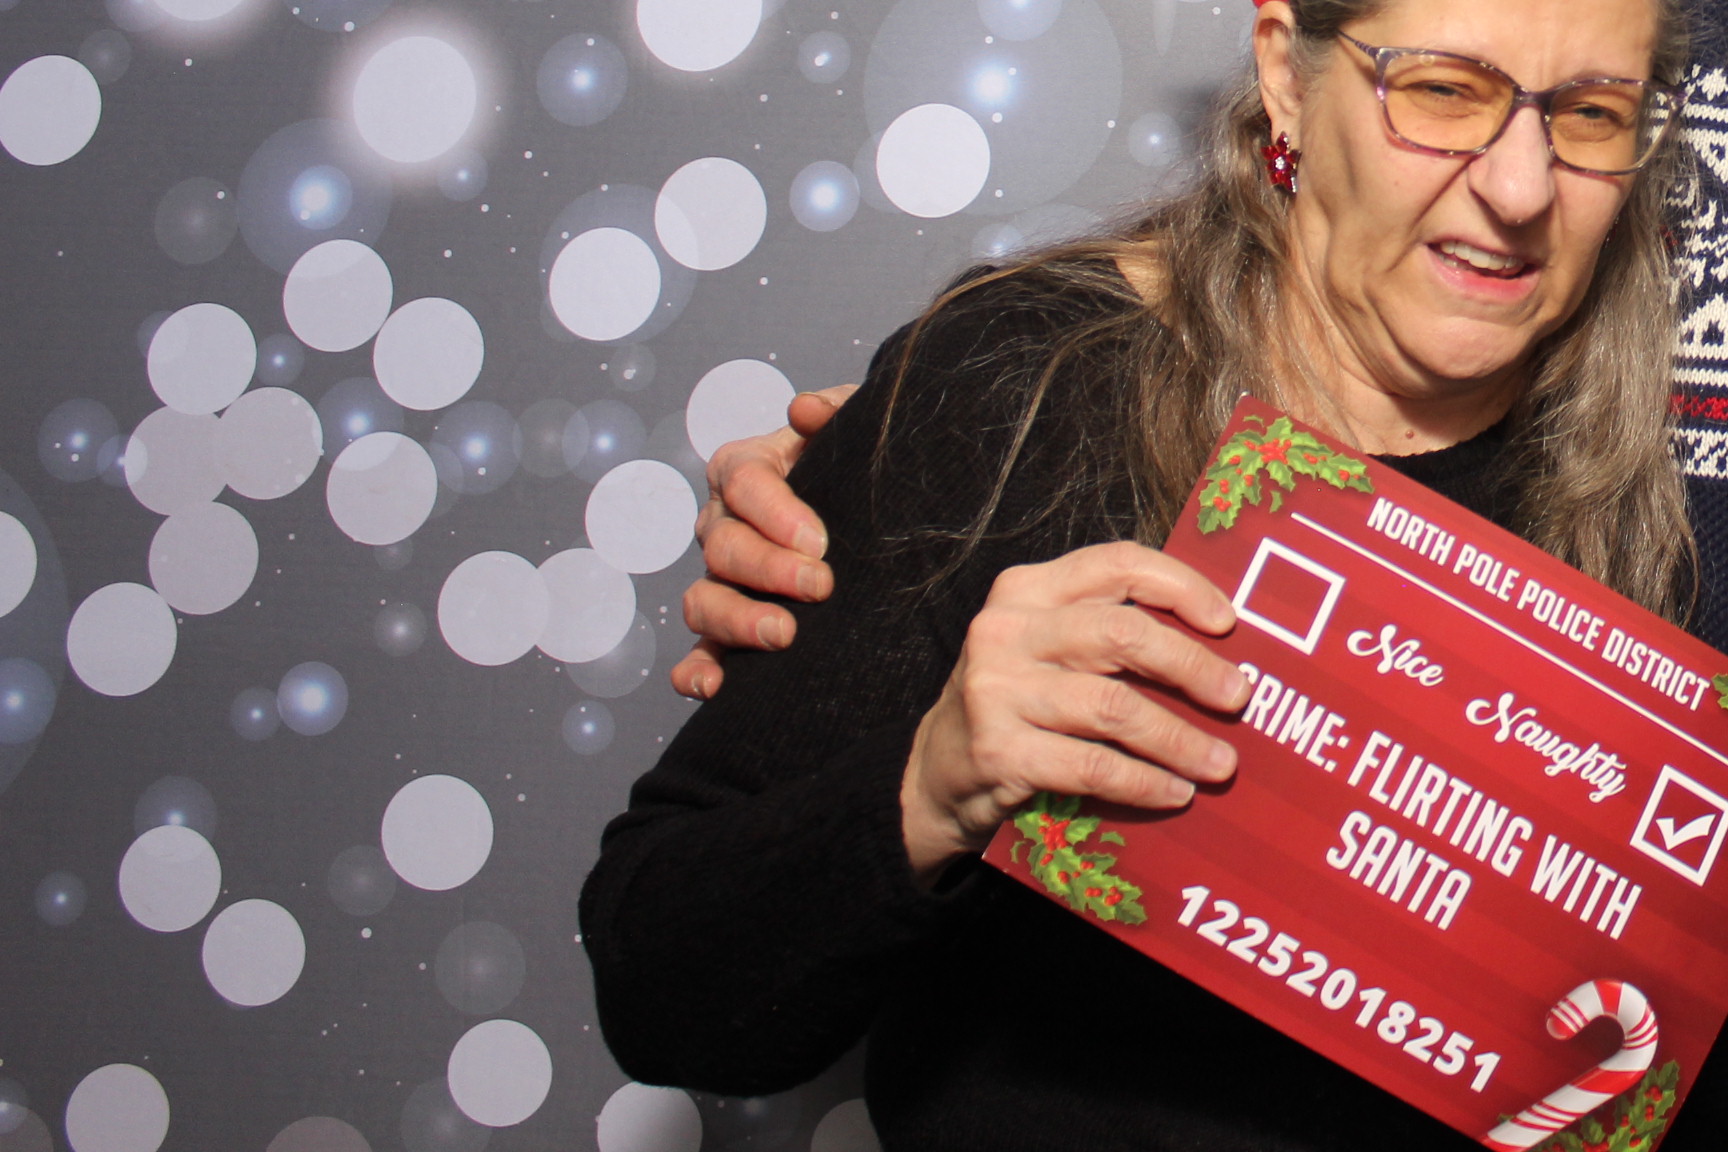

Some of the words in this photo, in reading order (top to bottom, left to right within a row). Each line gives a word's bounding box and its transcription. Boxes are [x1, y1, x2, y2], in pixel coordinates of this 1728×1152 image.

[1347, 624, 1444, 687] Nice
[1367, 498, 1452, 566] NORTH
[1453, 547, 1519, 602] POLE
[1517, 580, 1604, 651] POLICE
[1601, 628, 1710, 711] DISTRICT
[1465, 693, 1626, 803] Naughty
[1326, 811, 1472, 931] SANTA
[1347, 730, 1533, 877] FLIRTING
[1530, 835, 1642, 940] WITH
[1177, 885, 1501, 1093] 12252018251
